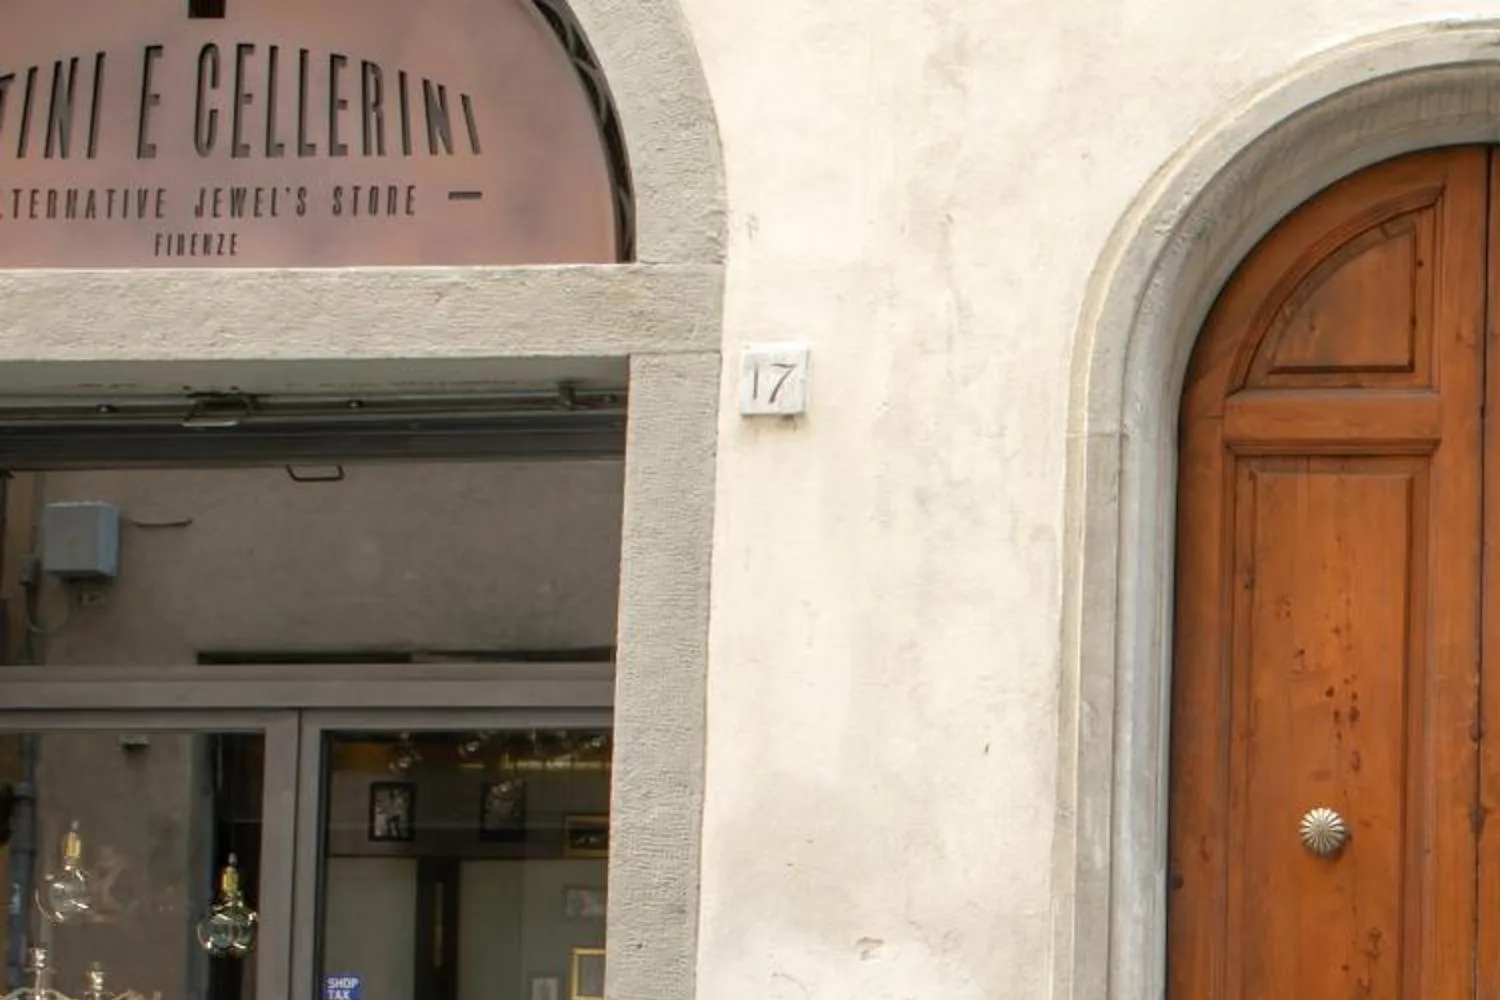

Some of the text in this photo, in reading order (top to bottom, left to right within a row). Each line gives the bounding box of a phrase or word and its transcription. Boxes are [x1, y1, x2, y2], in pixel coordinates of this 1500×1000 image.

[136, 44, 164, 160] E
[193, 42, 481, 159] CELLERINI
[0, 183, 417, 220] TERNATIVE JEWEL'S STORE
[153, 232, 239, 258] FIRENZE
[751, 361, 798, 405] 17
[327, 977, 360, 989] SHOP
[327, 989, 352, 1000] TAX
